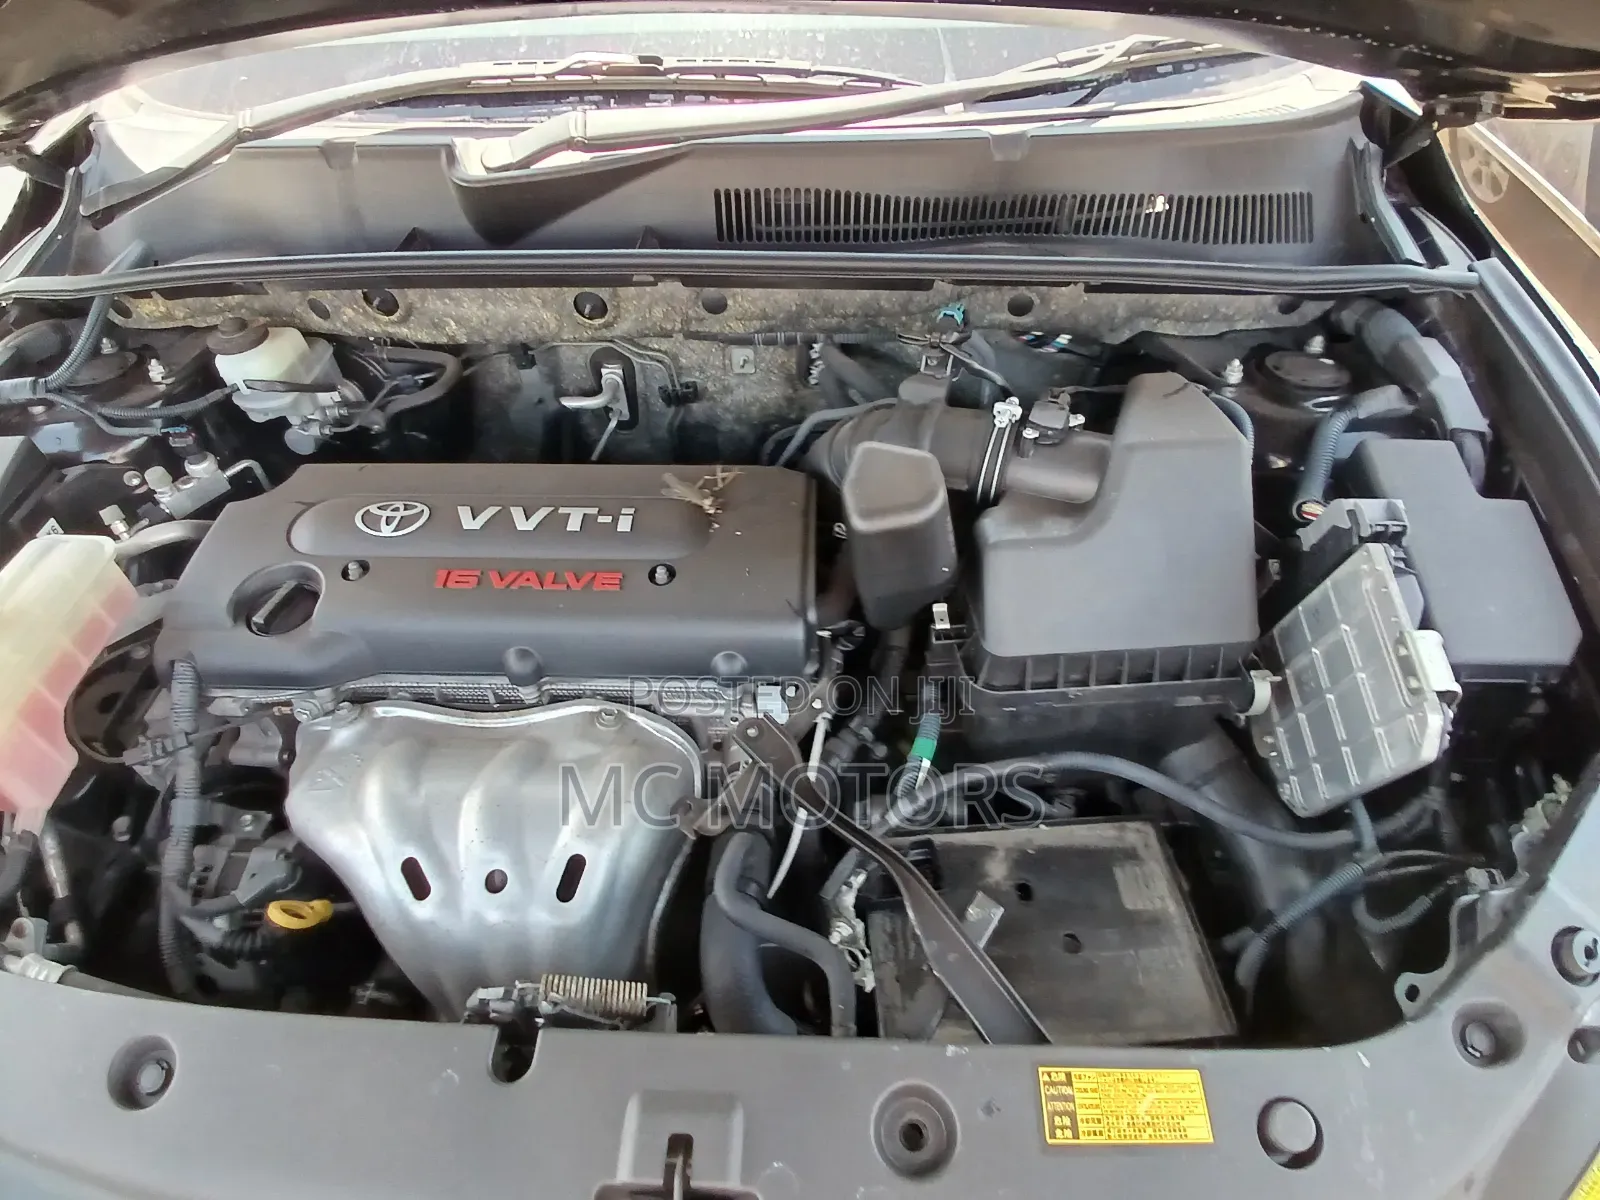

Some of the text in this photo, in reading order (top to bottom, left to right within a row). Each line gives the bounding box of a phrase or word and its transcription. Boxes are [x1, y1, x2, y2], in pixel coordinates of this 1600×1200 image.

[457, 505, 635, 533] VVT-i
[434, 568, 624, 592] 16 VALVE
[1044, 1085, 1074, 1096] CAUTION
